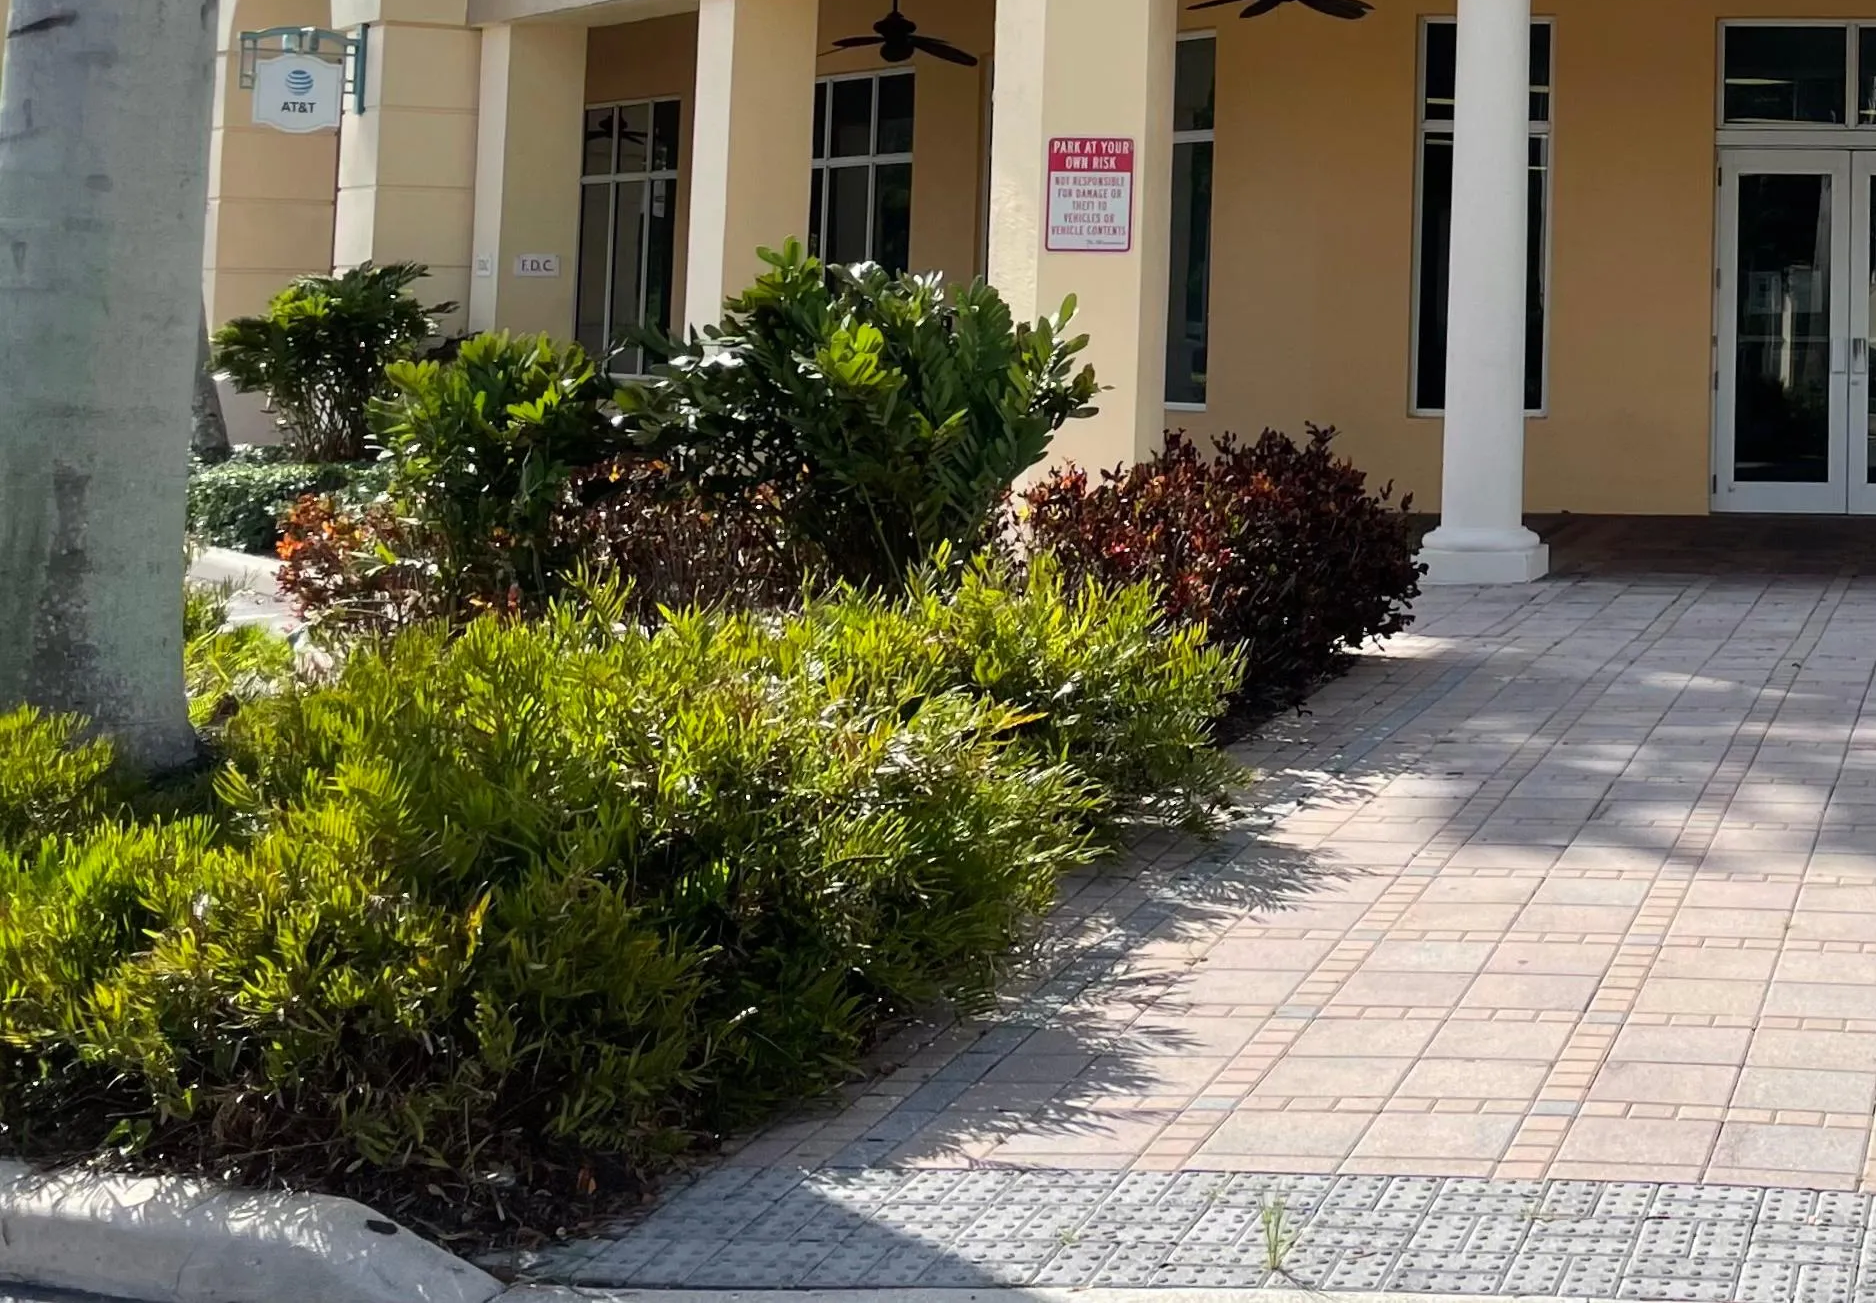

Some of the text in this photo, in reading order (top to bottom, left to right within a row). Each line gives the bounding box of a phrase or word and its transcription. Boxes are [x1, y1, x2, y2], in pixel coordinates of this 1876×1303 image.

[281, 101, 316, 113] AT&T
[1053, 140, 1129, 154] PARK AT YOUR
[1065, 156, 1116, 169] OWN RISK
[1055, 176, 1125, 186] NOT RESPONSIBLE
[1058, 188, 1122, 198] FOR DAMAGE OR
[1072, 200, 1107, 211] THEFT TO
[1063, 213, 1115, 223] VEHICLES OR
[1051, 225, 1126, 236] VEHICLE CONTENTS
